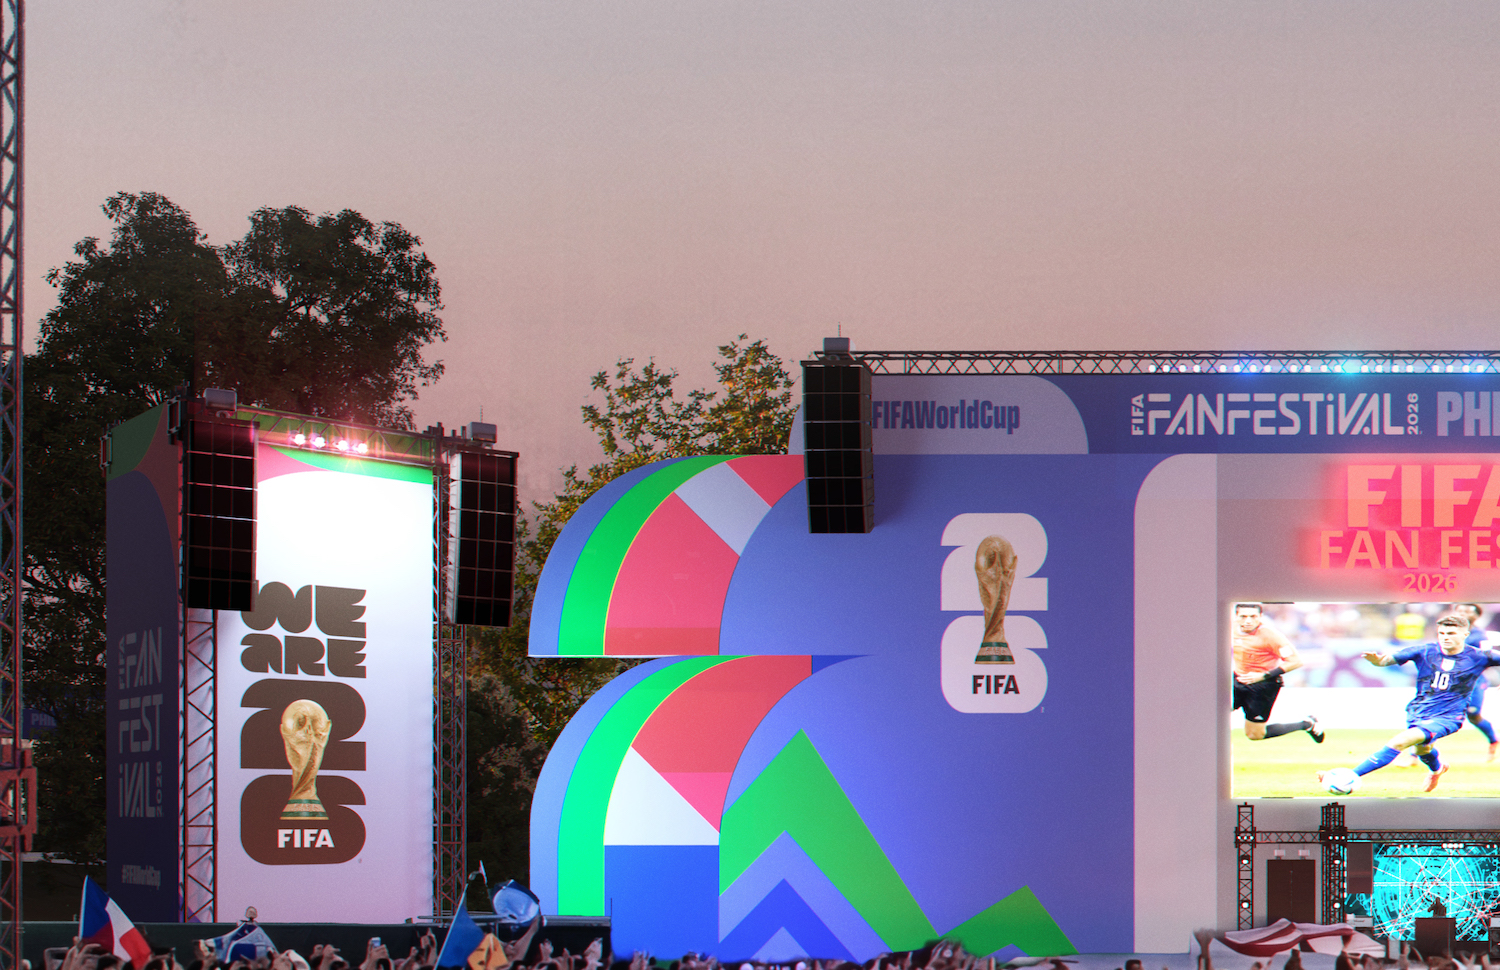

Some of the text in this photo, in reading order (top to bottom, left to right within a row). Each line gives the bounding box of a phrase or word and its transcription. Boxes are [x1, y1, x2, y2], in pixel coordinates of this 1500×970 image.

[1131, 394, 1144, 435] FIFA
[1407, 393, 1419, 435] 2026
[1320, 530, 1419, 569] FAN
[1402, 573, 1458, 593] 2026
[240, 581, 366, 639] WE
[972, 675, 1020, 694] FIFA
[1430, 670, 1450, 690] 10
[277, 829, 334, 848] FIFA
